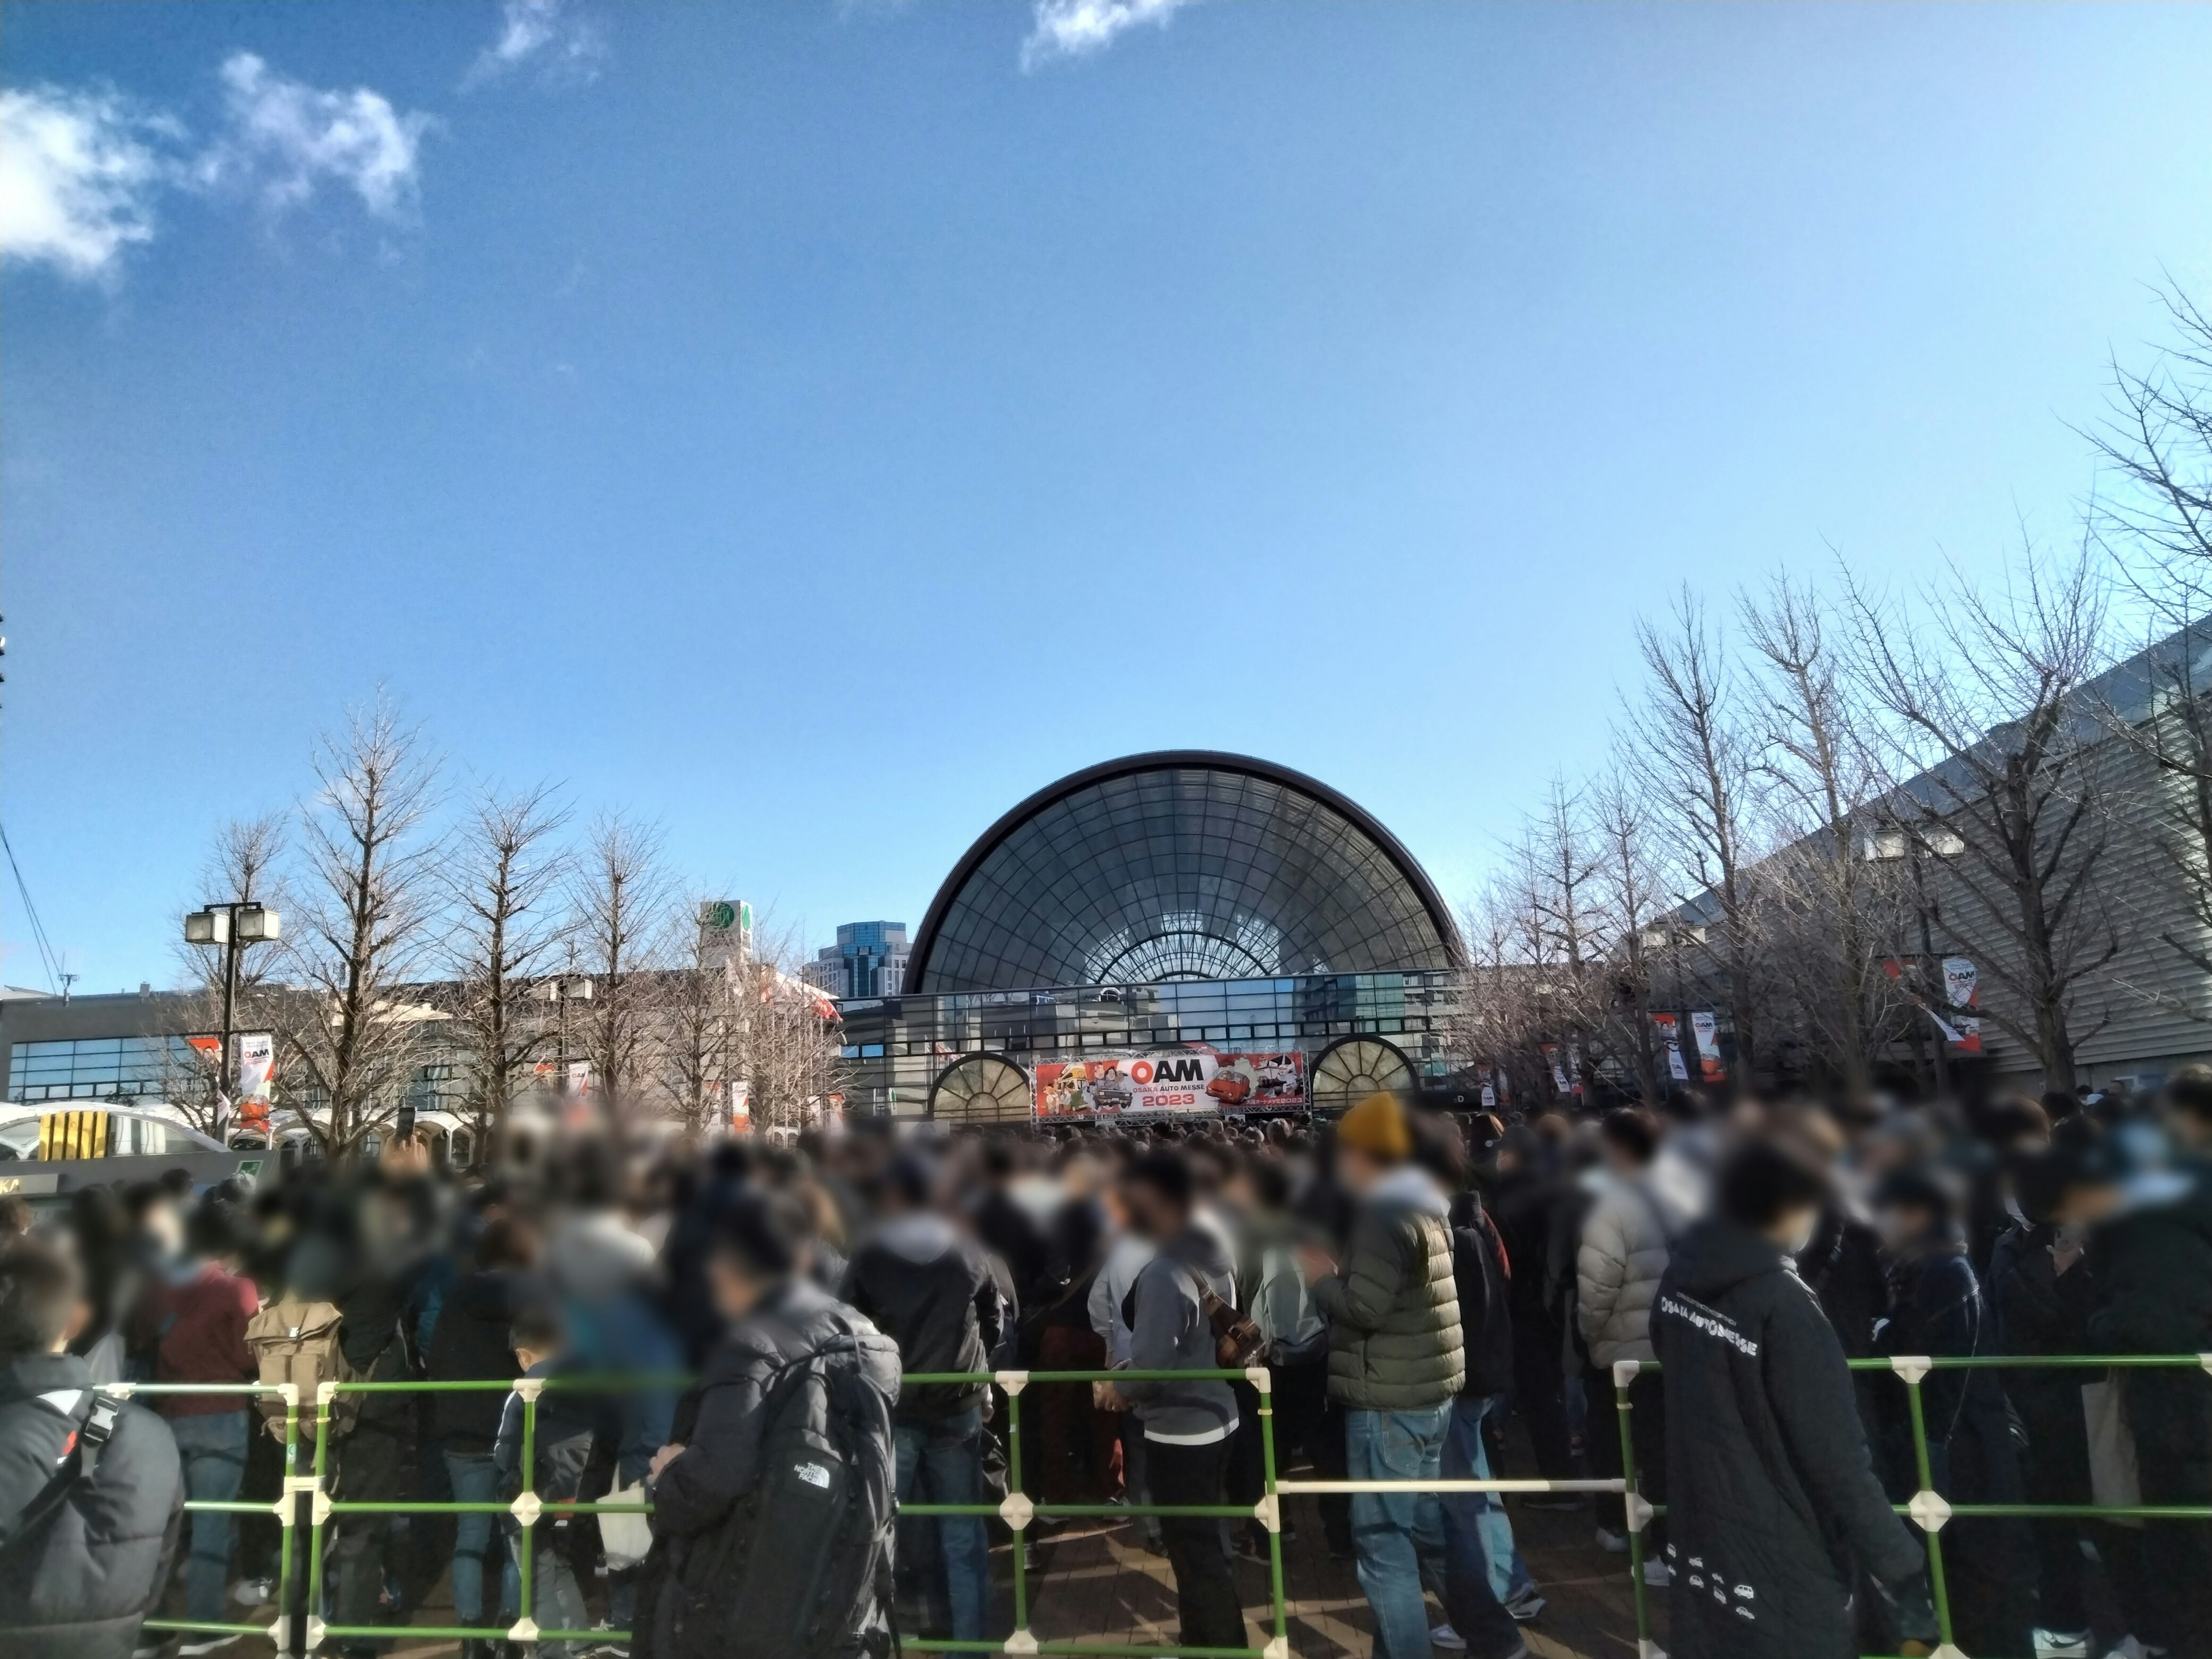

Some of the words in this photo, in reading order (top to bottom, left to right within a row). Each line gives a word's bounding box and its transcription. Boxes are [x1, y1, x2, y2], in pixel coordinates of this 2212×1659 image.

[244, 1049, 269, 1058] OAM
[1131, 1059, 1204, 1084] OAM
[1143, 1094, 1195, 1107] 2023
[794, 1464, 819, 1479] NORTH
[807, 1462, 821, 1471] THE
[798, 1473, 817, 1483] FACE
